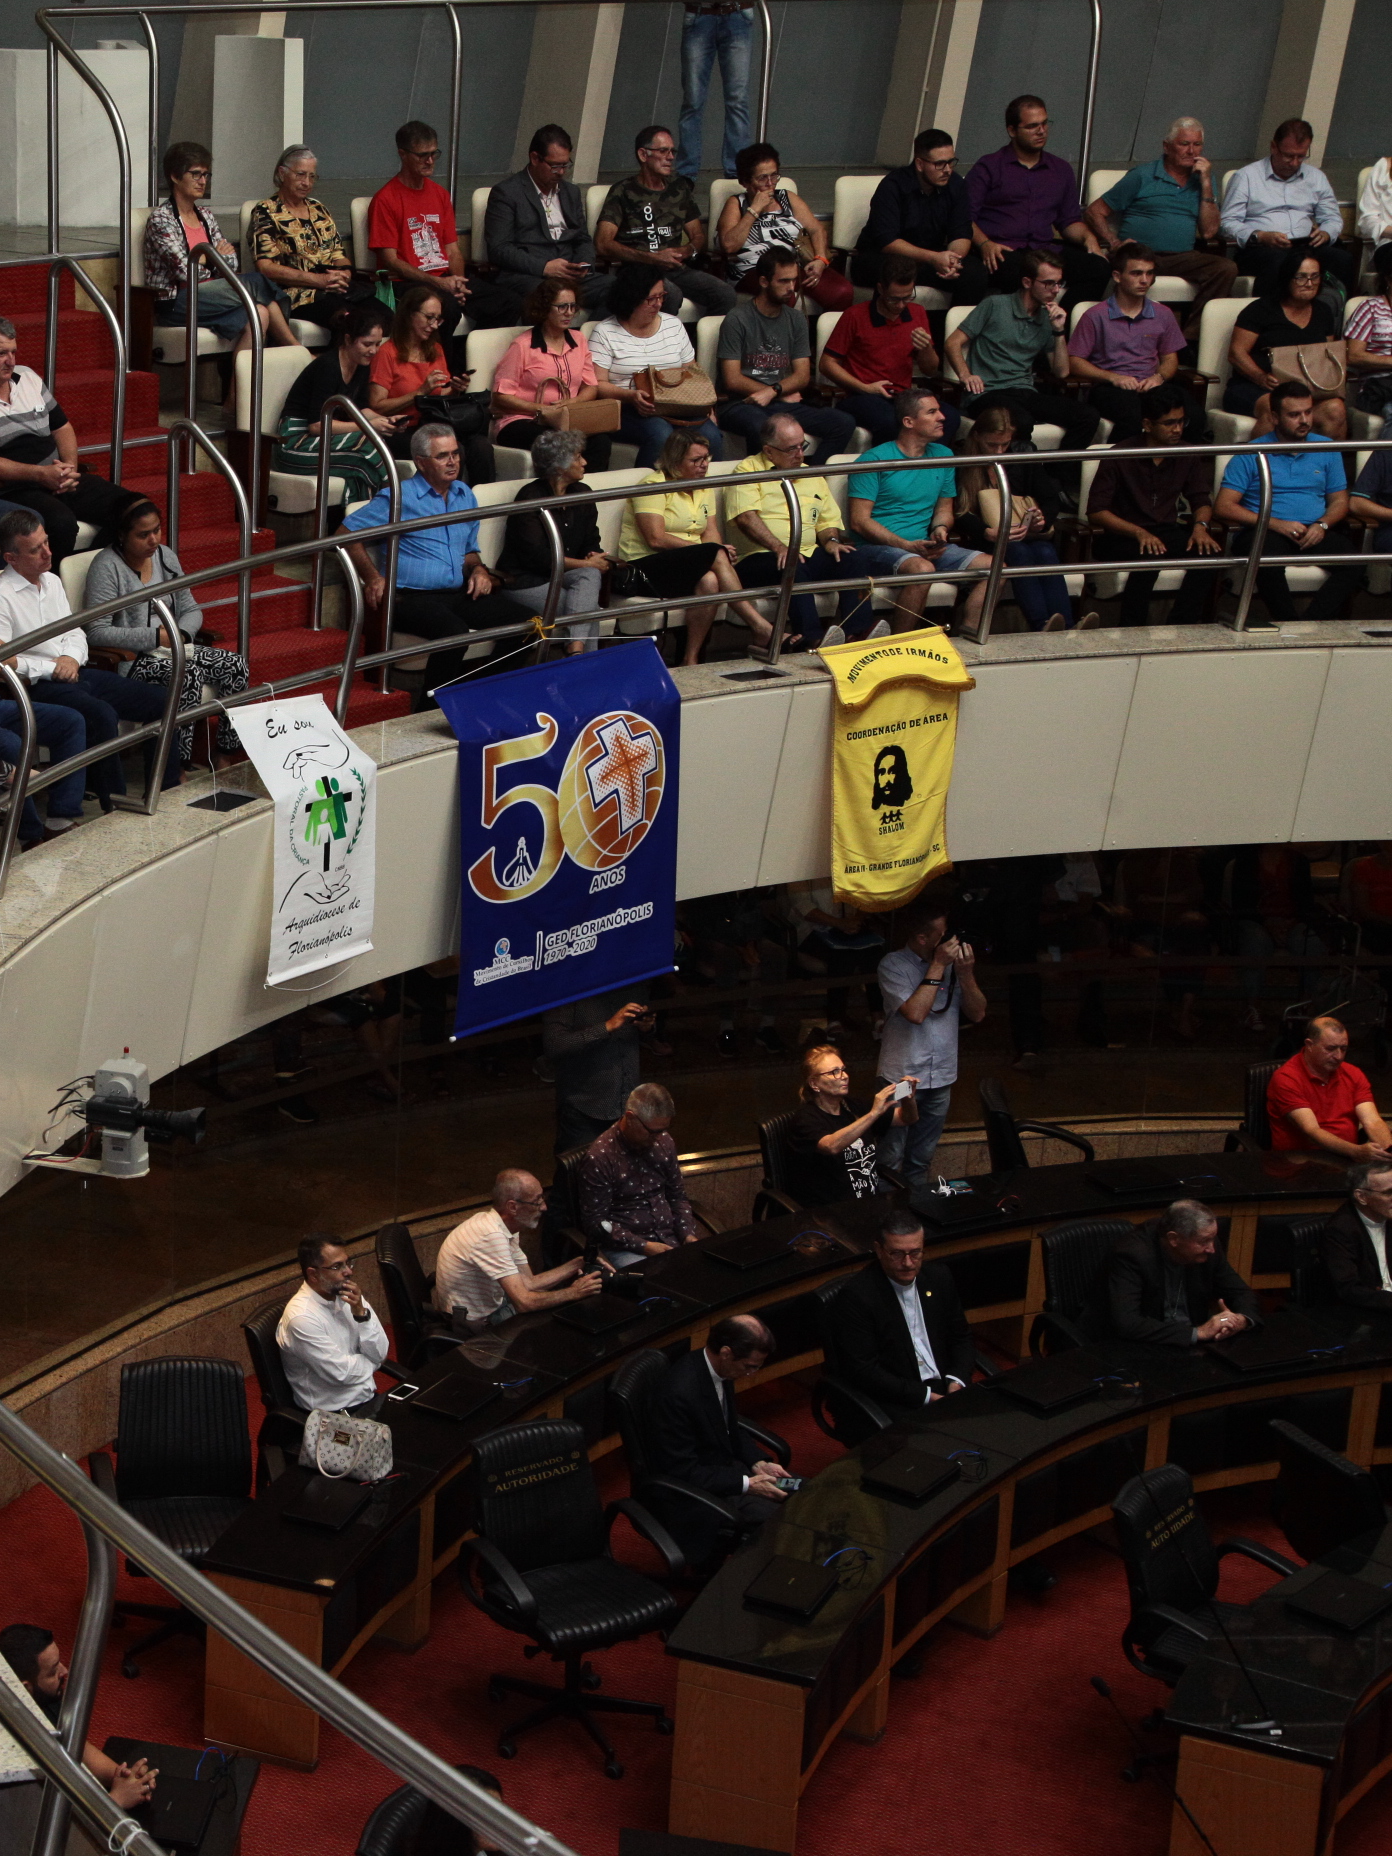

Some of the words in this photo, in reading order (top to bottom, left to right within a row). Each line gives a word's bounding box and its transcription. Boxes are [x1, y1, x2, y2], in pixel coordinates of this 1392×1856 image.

[905, 648, 949, 664] IRMÃOS
[265, 718, 288, 739] Eu
[293, 720, 314, 731] sou
[846, 721, 907, 741] COORDENAÇÃO
[909, 718, 921, 728] DE
[923, 712, 948, 725] ÁREA
[468, 711, 665, 904] 50
[878, 822, 905, 835] SHALOM
[869, 861, 893, 872] GRANDE
[932, 843, 940, 853] SC
[589, 866, 626, 893] ANOS
[282, 904, 346, 936] Arquidiocese
[348, 896, 361, 911] de
[547, 931, 568, 949] GED
[569, 903, 653, 941] FLORIANÓPOLIS
[288, 925, 353, 961] Florianópolis
[544, 946, 567, 964] 1970
[573, 937, 596, 954] 2020
[495, 1462, 579, 1493] AUTORIDADE
[504, 1456, 564, 1477] RESERVADO
